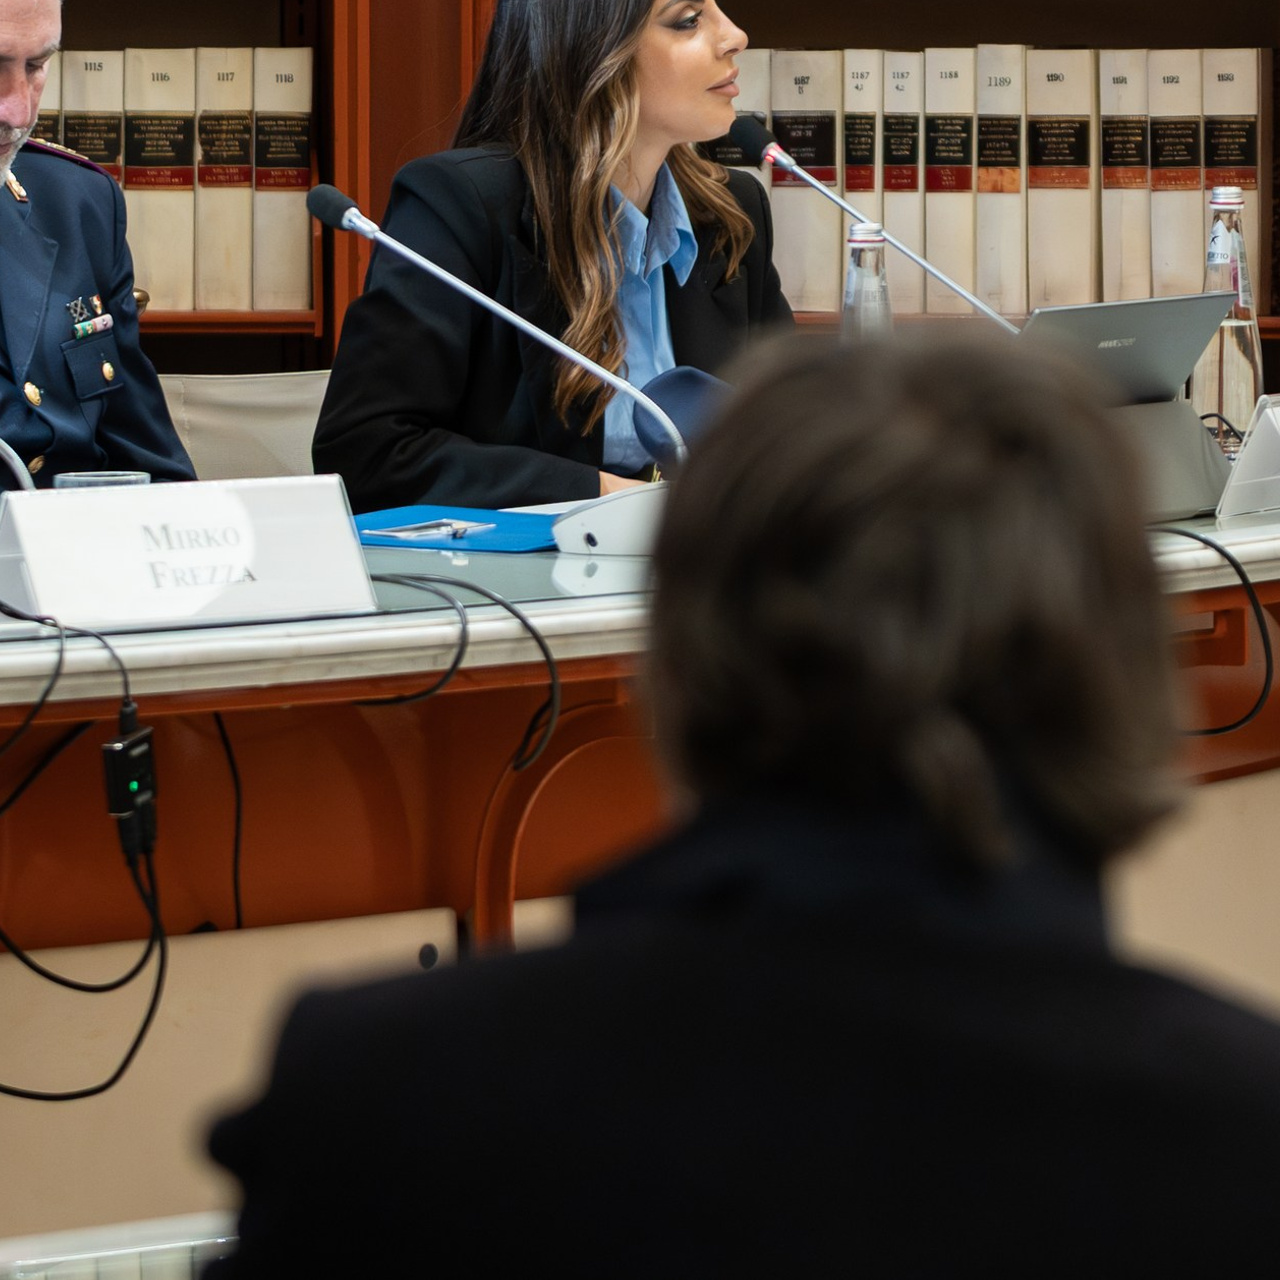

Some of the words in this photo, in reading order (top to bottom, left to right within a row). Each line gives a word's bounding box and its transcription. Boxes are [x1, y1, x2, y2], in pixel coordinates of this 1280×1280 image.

[84, 62, 103, 72] 1115
[151, 72, 170, 82] 1116
[217, 72, 234, 82] 1117
[275, 73, 294, 83] 1118
[851, 71, 870, 79] 1187
[892, 71, 910, 79] 1187
[940, 71, 959, 79] 1188
[1046, 73, 1064, 82] 1190
[1217, 73, 1235, 82] 1193
[794, 76, 810, 85] 1187
[987, 76, 1012, 87] 1189
[1112, 76, 1128, 84] 1191
[1162, 76, 1180, 84] 1192
[142, 524, 241, 552] MIRKO
[148, 561, 258, 589] FREZZA
